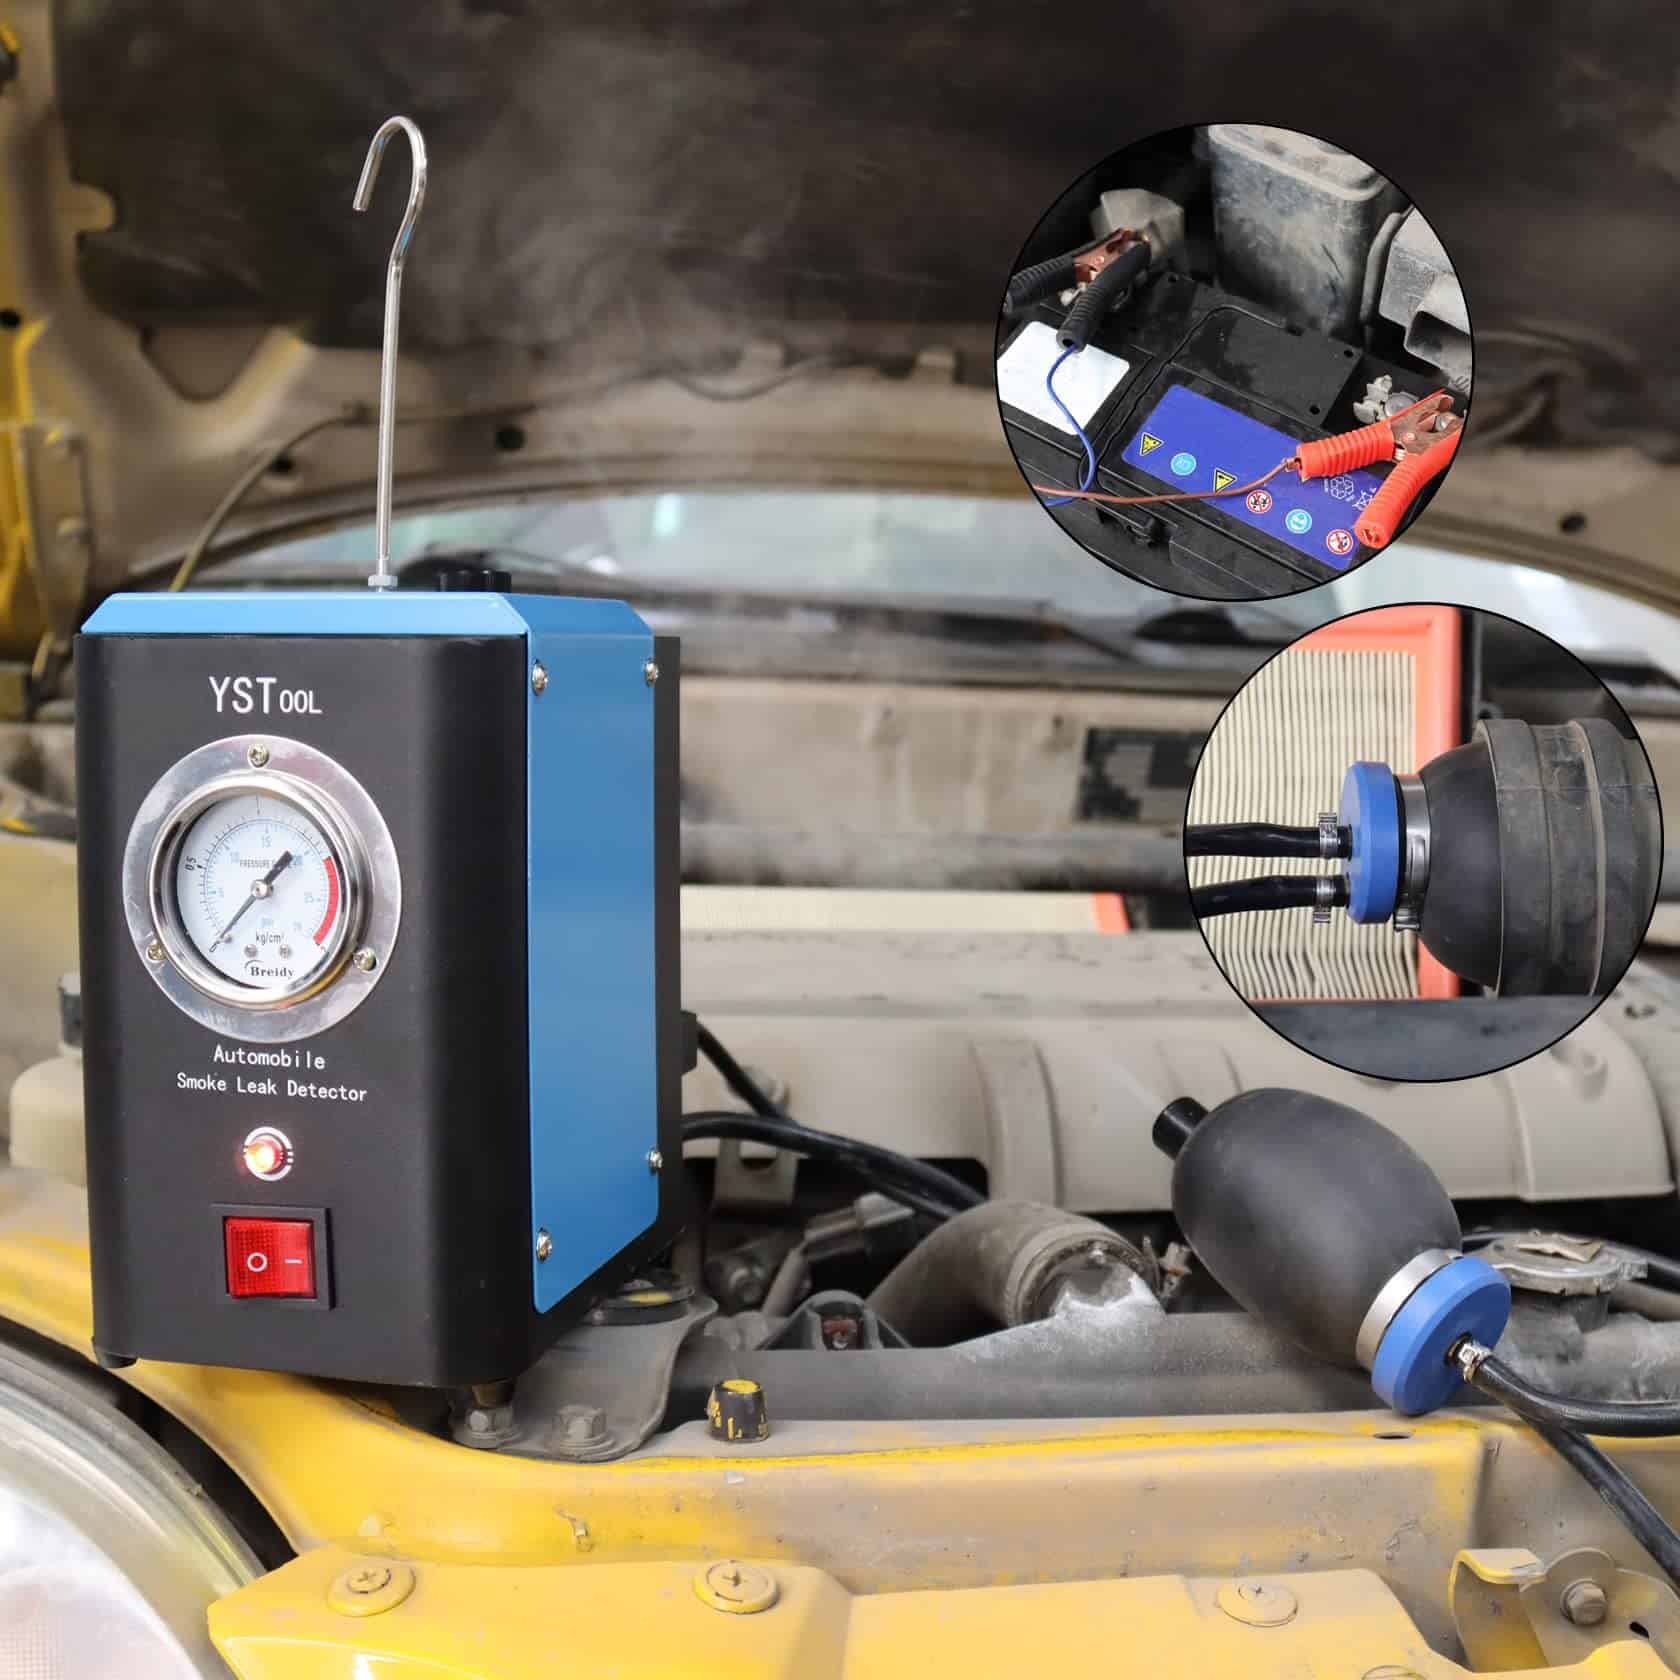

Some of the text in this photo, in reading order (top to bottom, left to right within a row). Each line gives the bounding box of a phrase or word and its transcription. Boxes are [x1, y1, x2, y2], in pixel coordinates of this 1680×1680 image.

[250, 966, 295, 980] Breidy
[214, 1044, 326, 1070] Automobile
[177, 1072, 368, 1102] Smoke Leak Detector
